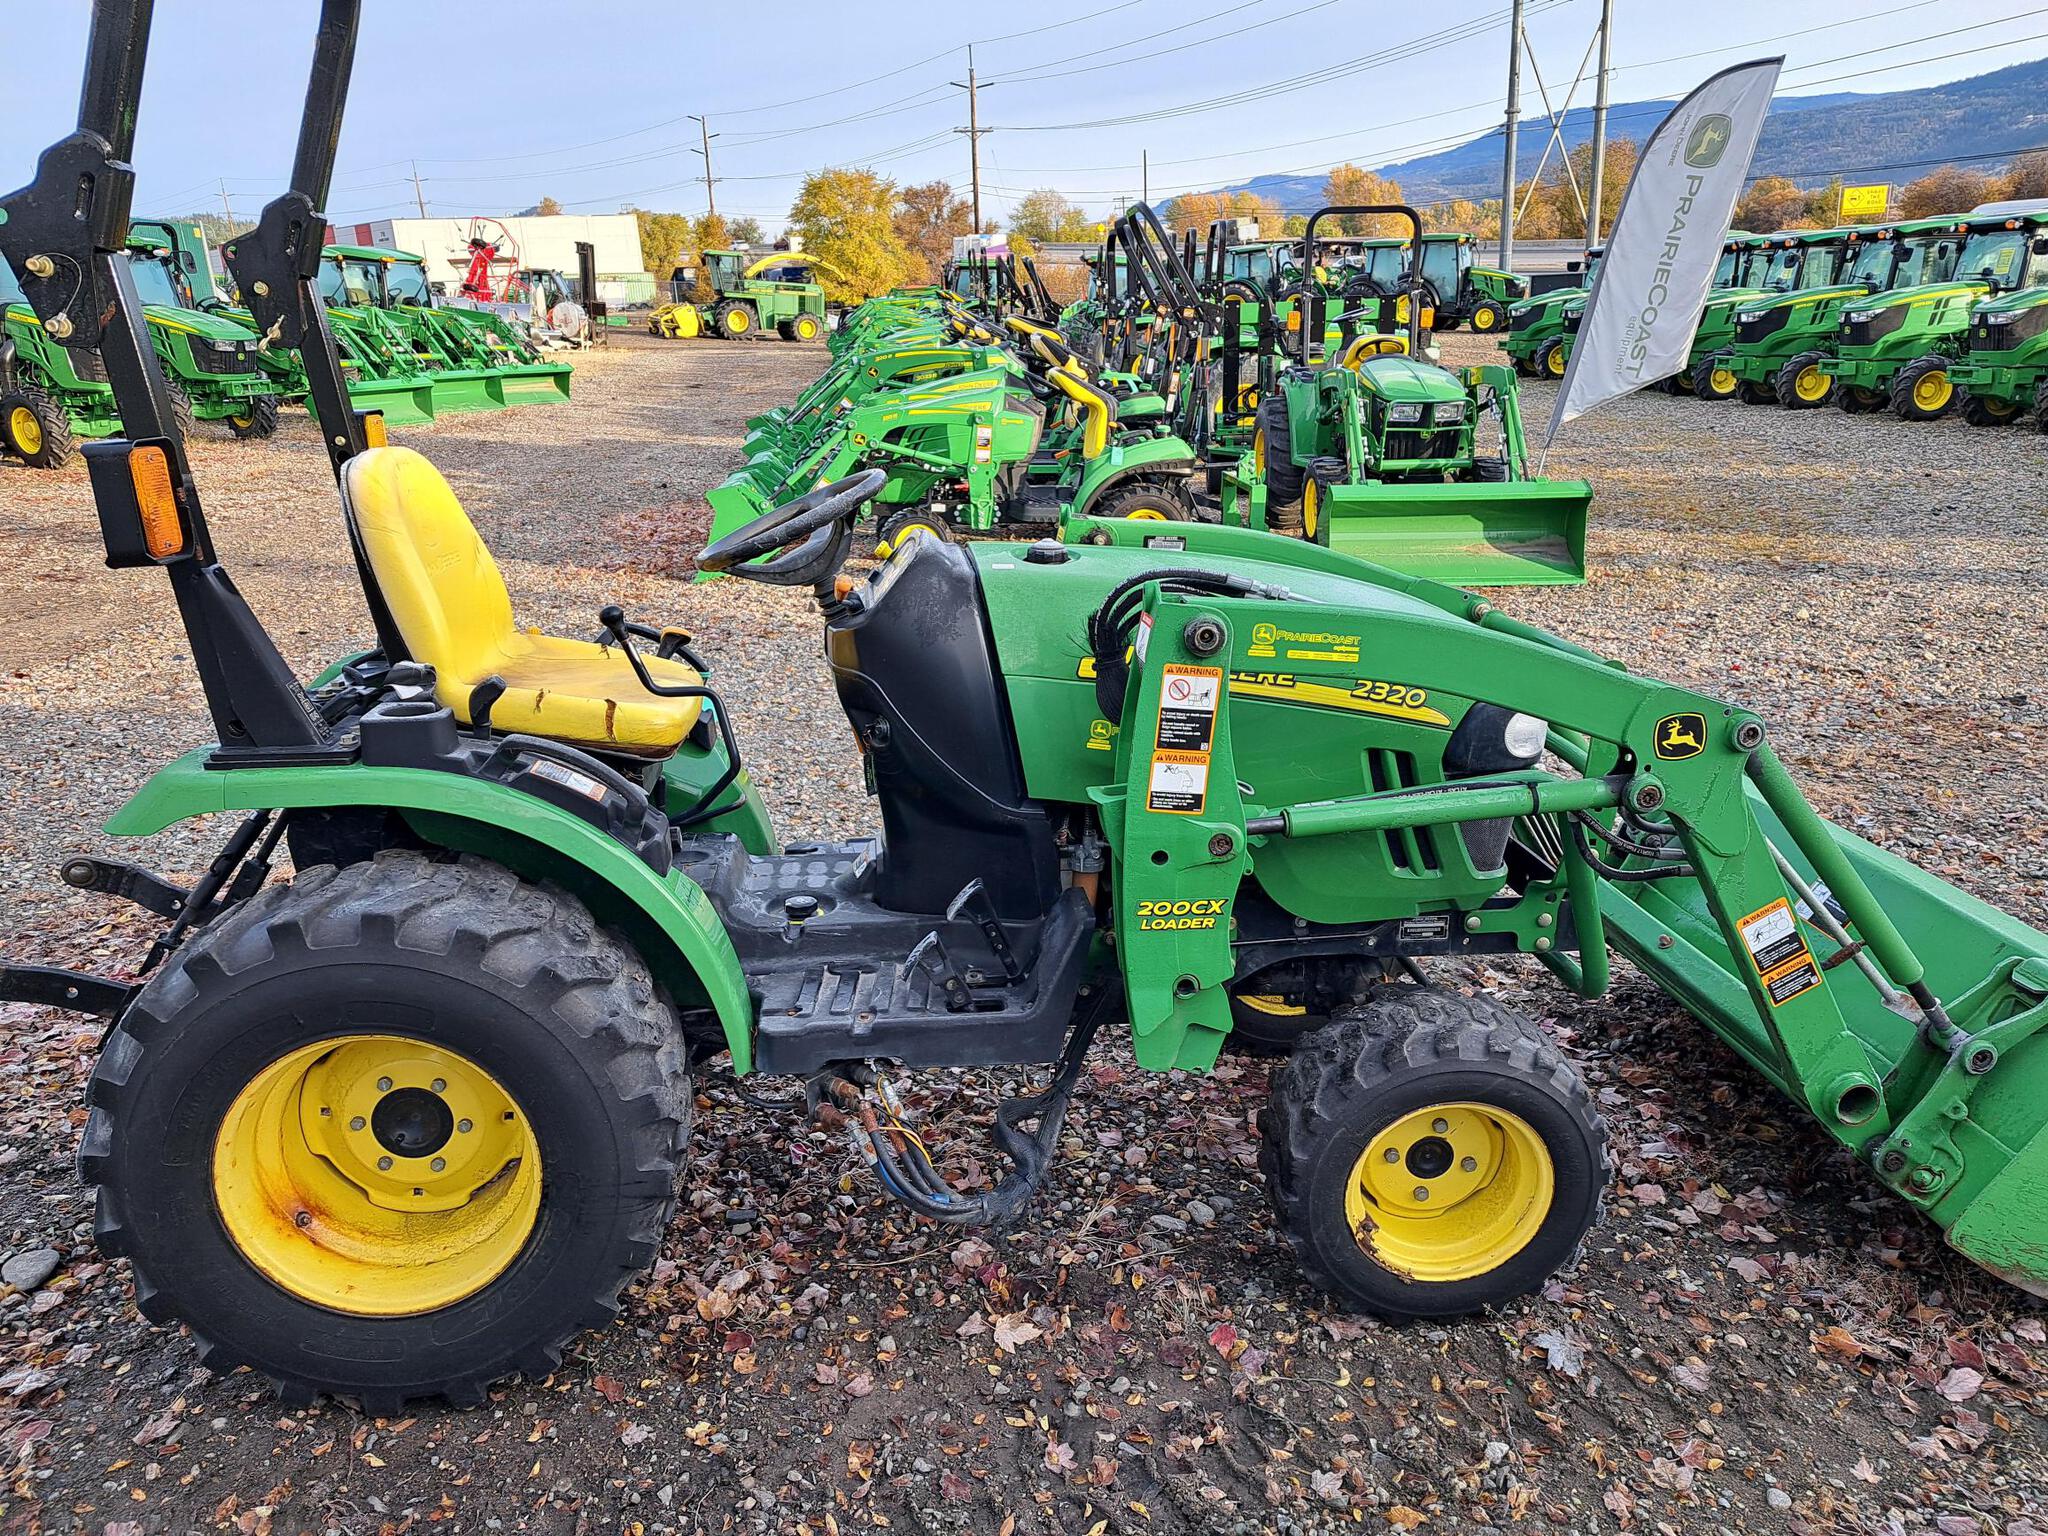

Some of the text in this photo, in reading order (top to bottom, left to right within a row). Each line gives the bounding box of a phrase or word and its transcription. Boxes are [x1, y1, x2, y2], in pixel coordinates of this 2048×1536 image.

[1614, 315, 1638, 375] equipment
[1175, 666, 1219, 676] WARNING
[1350, 680, 1427, 708] 2320
[1164, 754, 1207, 763] WARNING
[1137, 899, 1228, 916] 200CX
[1750, 902, 1782, 922] WARNING
[1140, 918, 1216, 930] LOADER
[1775, 957, 1807, 977] WARNING
